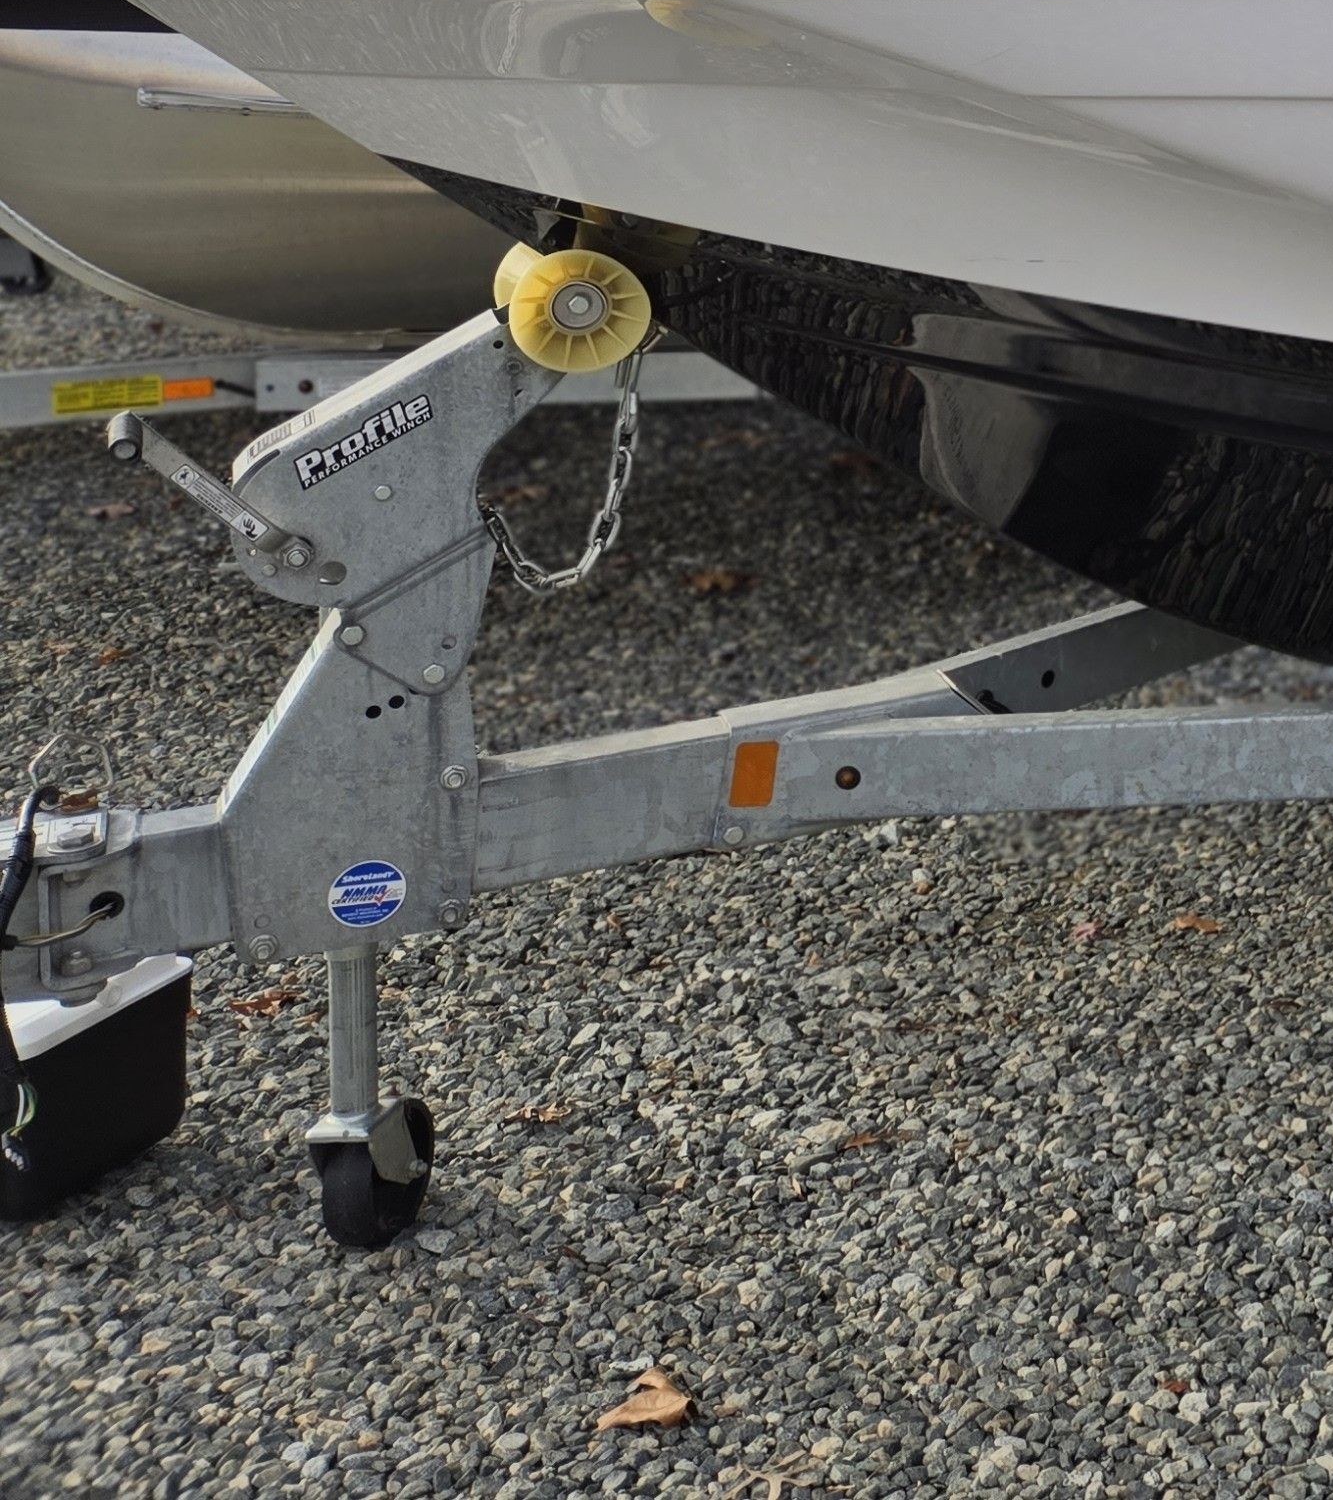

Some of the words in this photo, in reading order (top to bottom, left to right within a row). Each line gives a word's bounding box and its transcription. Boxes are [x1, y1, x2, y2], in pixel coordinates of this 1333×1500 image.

[295, 395, 430, 481] Profile
[304, 436, 389, 488] PERFORMANCE
[391, 411, 432, 439] WINCH
